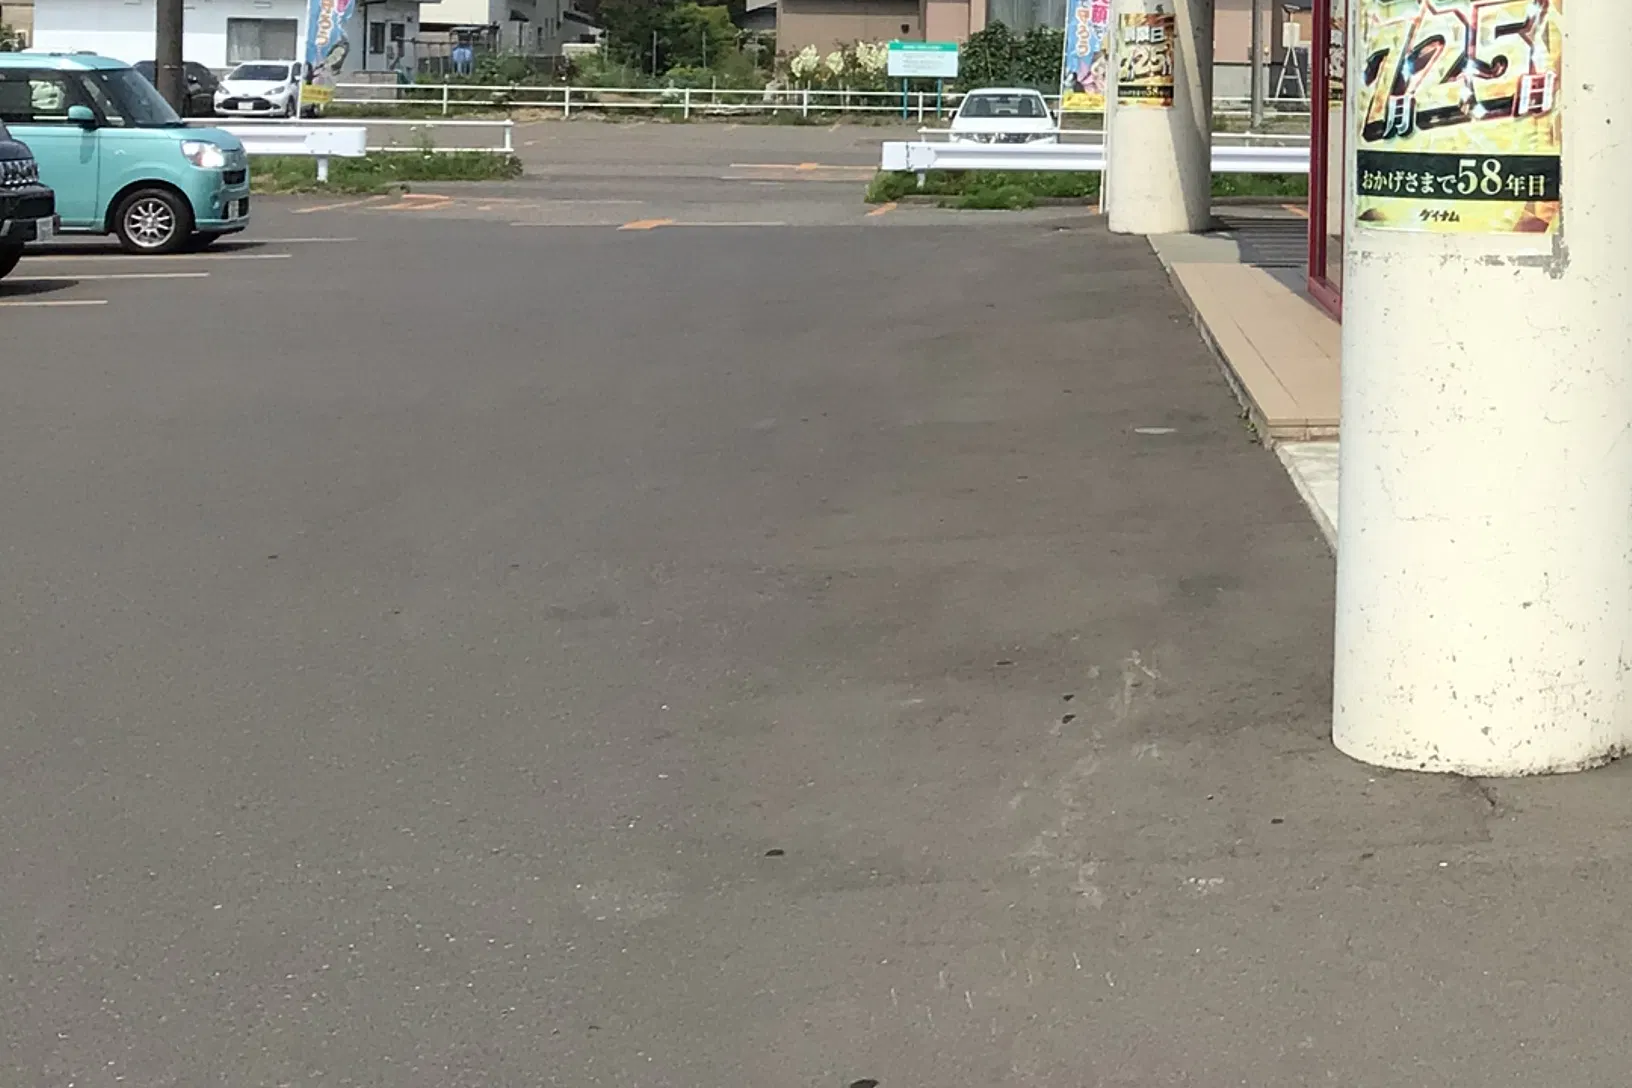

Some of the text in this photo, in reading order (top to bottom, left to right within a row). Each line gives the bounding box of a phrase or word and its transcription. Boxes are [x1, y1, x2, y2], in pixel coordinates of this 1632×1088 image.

[1362, 159, 1545, 197] おかげさまで58年目
